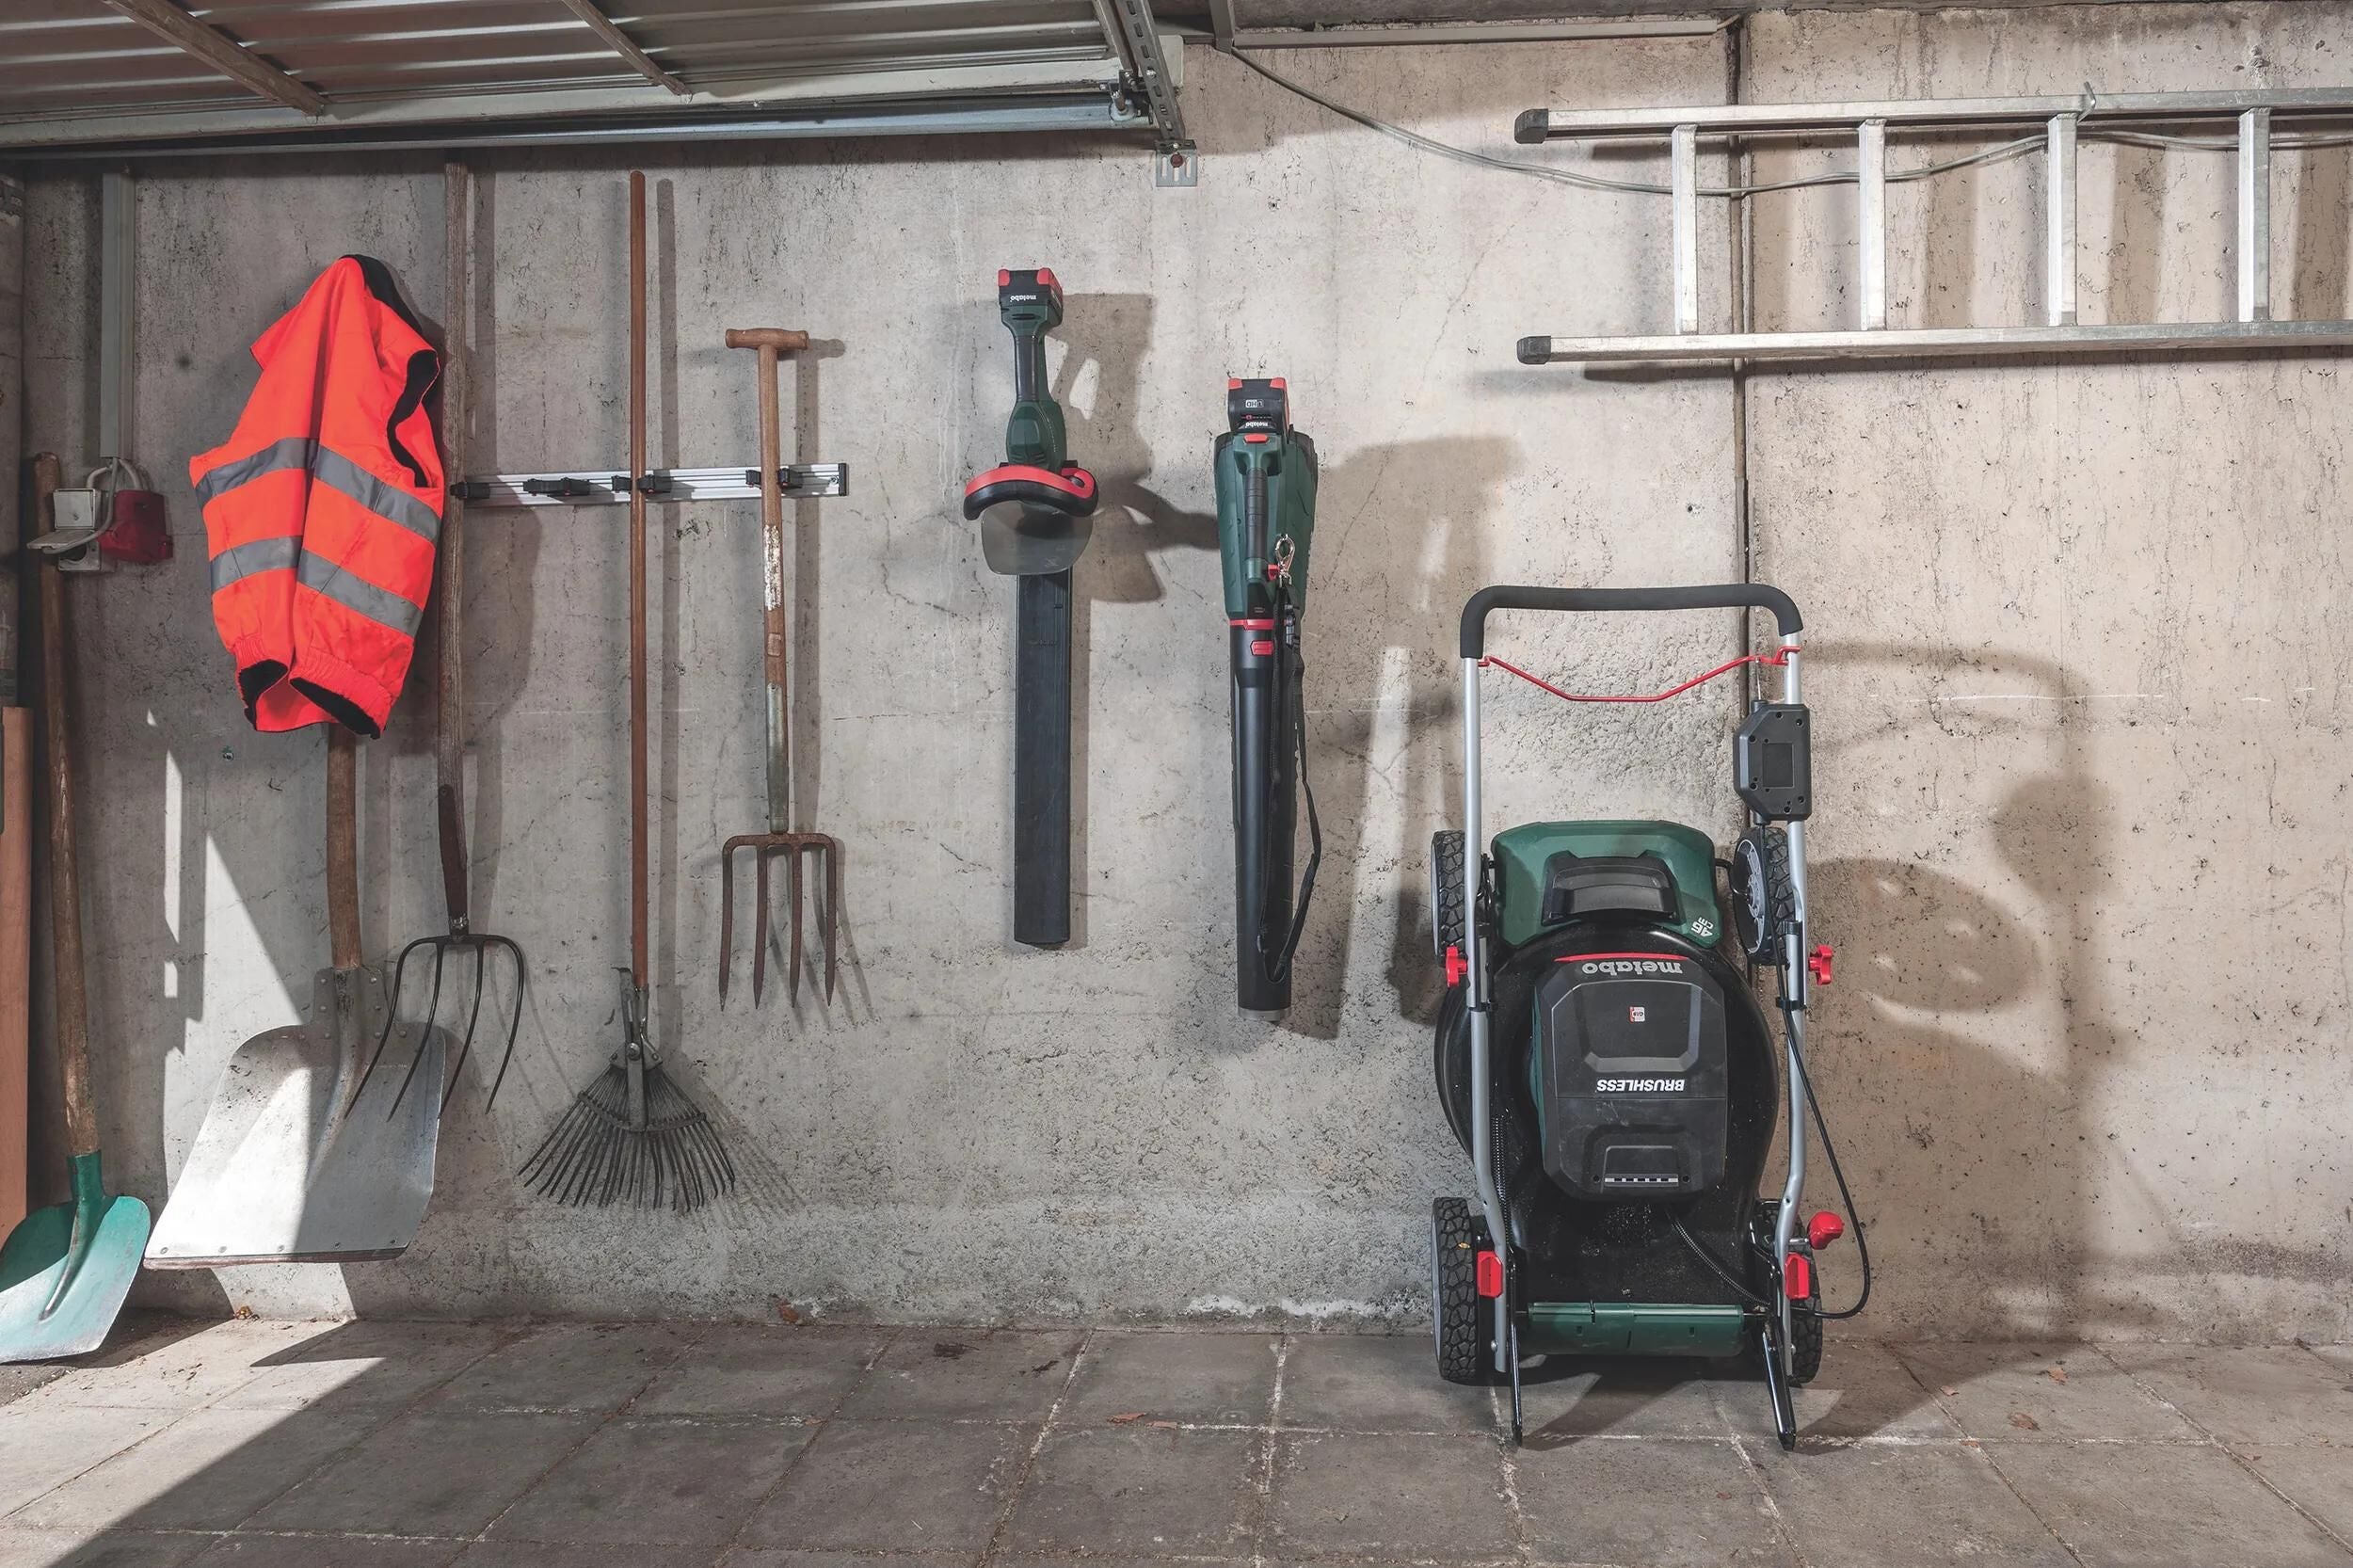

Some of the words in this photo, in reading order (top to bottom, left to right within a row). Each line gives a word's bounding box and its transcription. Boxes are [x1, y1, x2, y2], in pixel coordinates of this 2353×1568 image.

[1691, 921, 1713, 937] 46
[1582, 961, 1683, 975] metabo
[1597, 1080, 1686, 1092] BRUSHLESS
